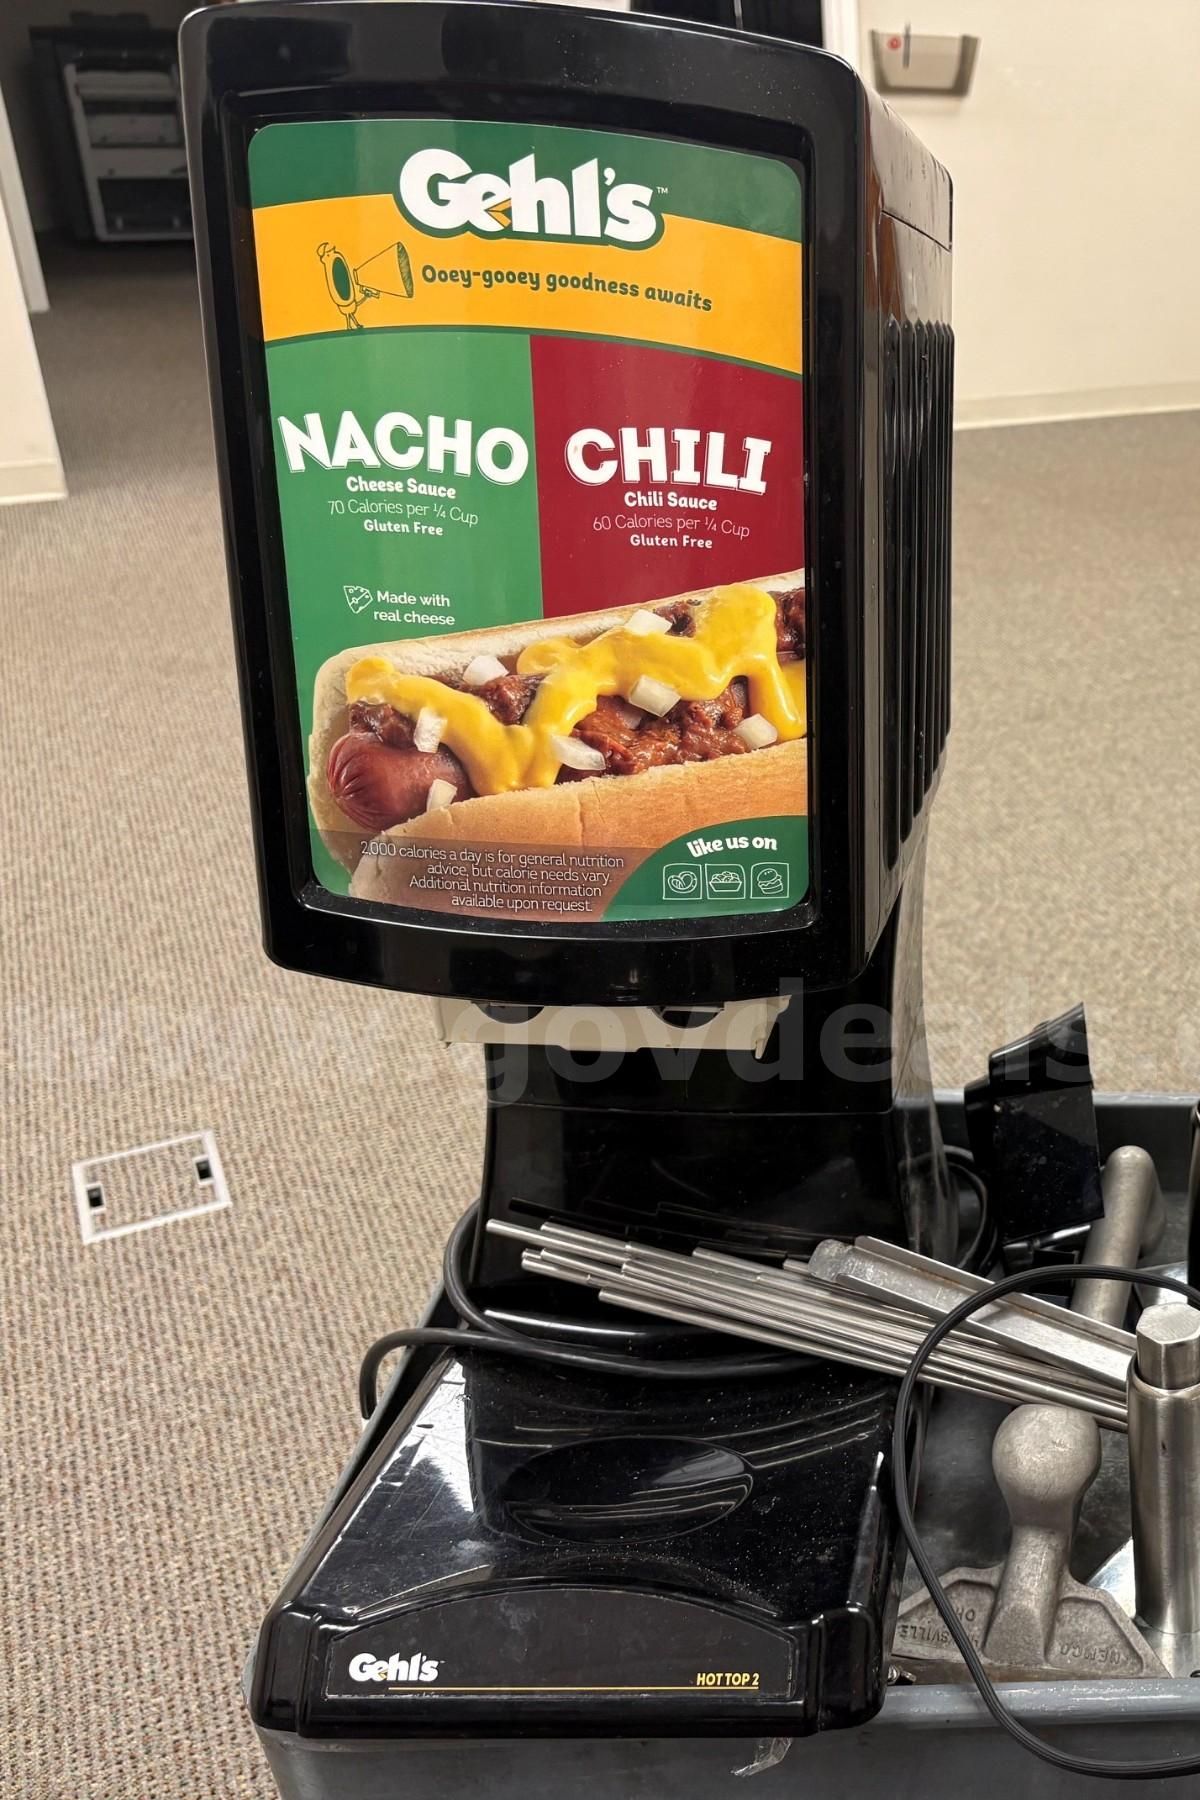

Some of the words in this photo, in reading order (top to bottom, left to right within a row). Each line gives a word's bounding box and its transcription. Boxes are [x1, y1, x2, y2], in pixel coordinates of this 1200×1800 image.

[400, 148, 657, 243] Gehl's
[421, 264, 541, 291] Ooey-gooey
[546, 272, 640, 298] goodness
[645, 286, 713, 312] awaits
[278, 410, 530, 486] NACHO
[564, 427, 773, 495] CHILI
[346, 475, 404, 493] Cheese
[407, 478, 457, 499] Sauce
[328, 500, 345, 515] 70
[348, 499, 403, 514] Calories
[406, 504, 430, 518] per
[449, 506, 479, 527] Cup
[624, 491, 664, 507] Chili
[667, 491, 718, 511] Sauce
[363, 519, 410, 533] Gluten
[413, 521, 444, 536] Free
[592, 516, 612, 531] 60
[615, 513, 673, 530] Calories
[676, 517, 700, 533] per
[721, 519, 750, 541] Cup
[630, 534, 678, 547] Gluten
[682, 535, 713, 549] Free
[376, 590, 417, 606] Made
[420, 592, 451, 607] with
[373, 608, 401, 622] real
[403, 610, 456, 625] cheese
[360, 840, 397, 857] 2,000
[399, 846, 447, 860] calories
[449, 851, 457, 861] a
[459, 848, 481, 865] day
[485, 851, 495, 863] is
[497, 850, 517, 864] for
[519, 852, 567, 867] general
[569, 854, 624, 868] nutrition
[686, 837, 724, 858] like
[725, 836, 750, 850] us
[752, 836, 778, 851] on
[409, 875, 471, 892] Additional
[473, 880, 526, 894] nutrition
[529, 883, 602, 897] information
[427, 862, 469, 877] advice,
[472, 864, 493, 878] but
[496, 866, 538, 880] calorie
[541, 867, 579, 882] needs
[582, 871, 613, 886] vary.
[451, 894, 504, 909] available
[507, 898, 539, 912] upon
[542, 899, 593, 914] request.
[348, 1652, 440, 1682] Gehl's
[696, 1671, 724, 1686] HOT
[724, 1671, 751, 1686] TOP
[751, 1671, 760, 1686] 2
